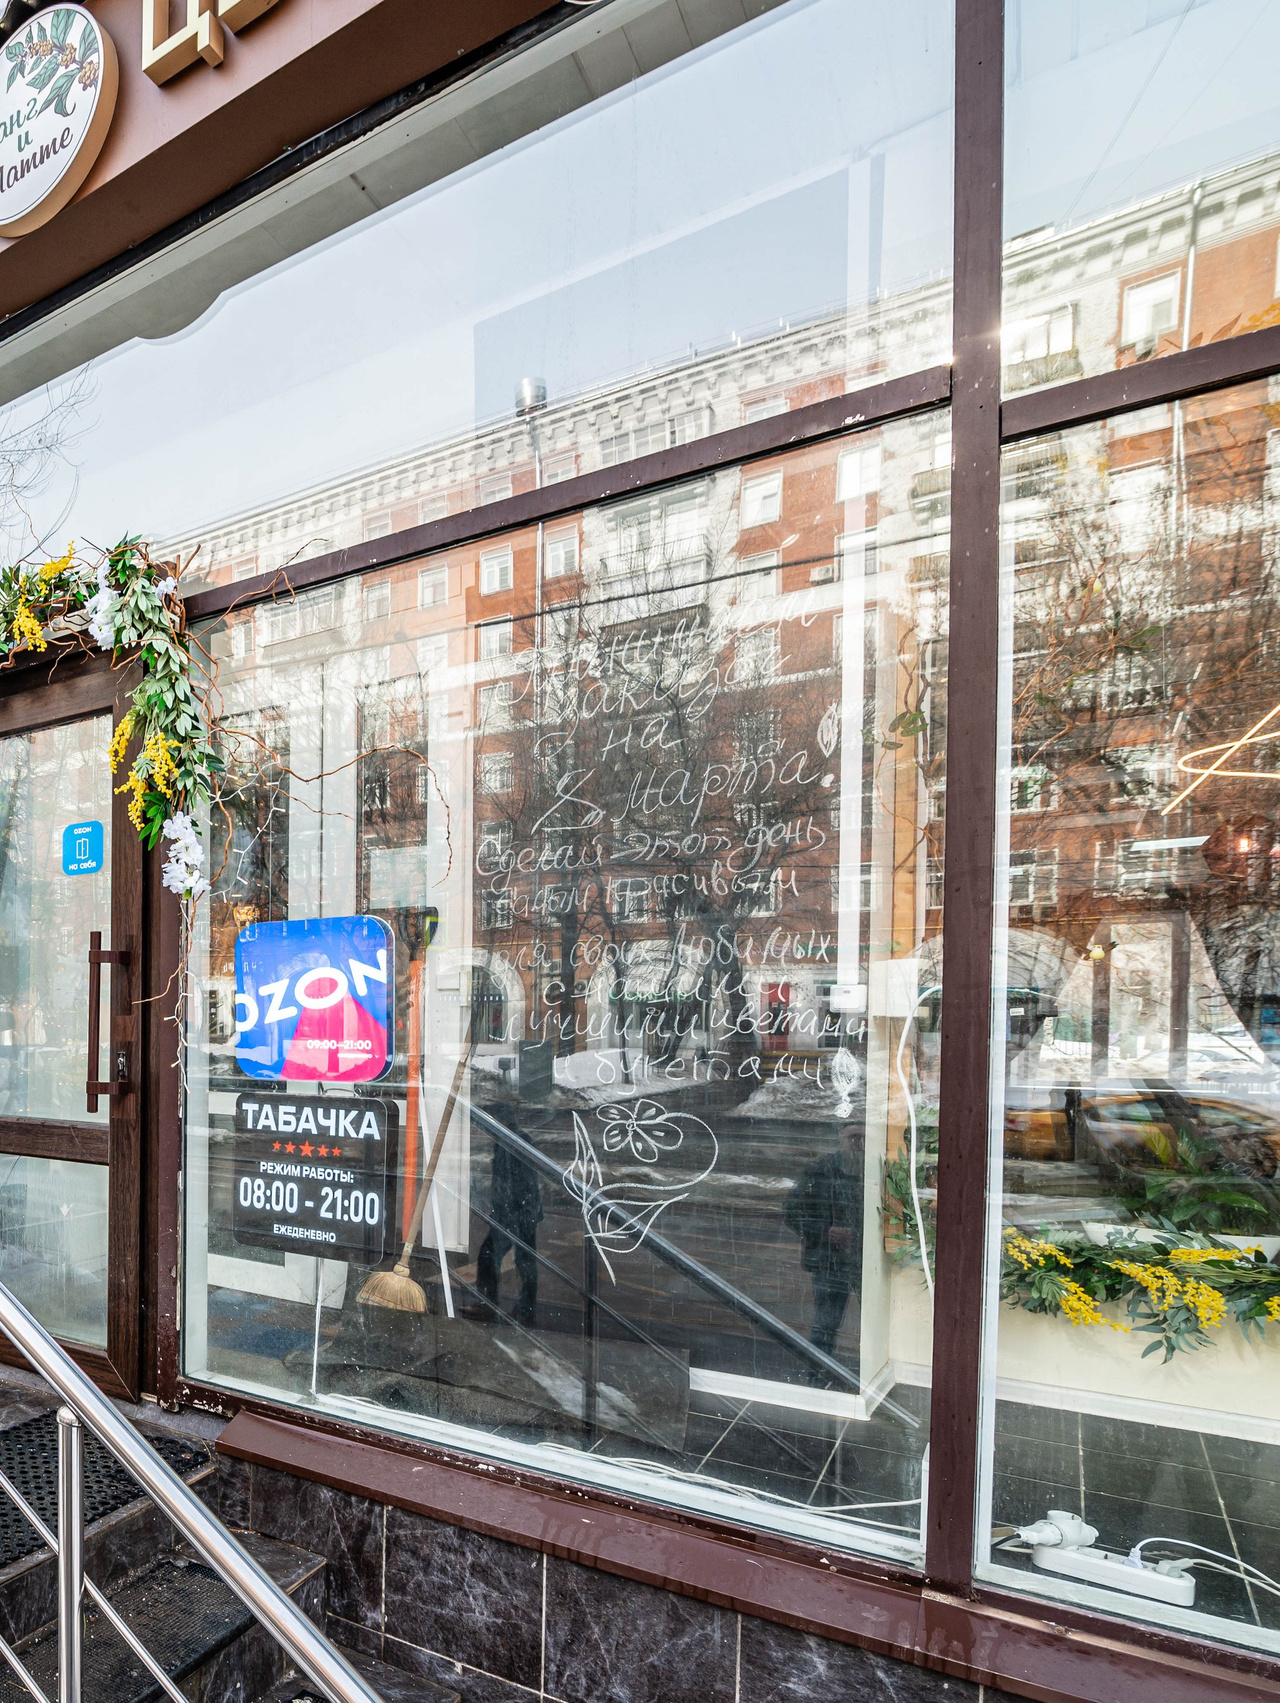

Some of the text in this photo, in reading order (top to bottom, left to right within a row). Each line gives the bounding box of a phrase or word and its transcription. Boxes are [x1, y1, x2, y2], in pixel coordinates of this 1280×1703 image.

[17, 130, 33, 153] и
[602, 717, 684, 761] на
[531, 769, 607, 834] 8
[476, 829, 603, 895] Сделай
[726, 817, 827, 873] день
[235, 948, 388, 1032] OZON
[542, 981, 566, 1006] с
[710, 1001, 868, 1043] цветами
[551, 1055, 577, 1083] и
[241, 1102, 381, 1141] ТАБАЧКА
[259, 1161, 354, 1184] РЕЖИМ РАБОТЫ:
[239, 1176, 299, 1214] 08:00
[319, 1186, 380, 1226] 21:00
[273, 1223, 337, 1243] ЕЖЕДЕНЕВНО
